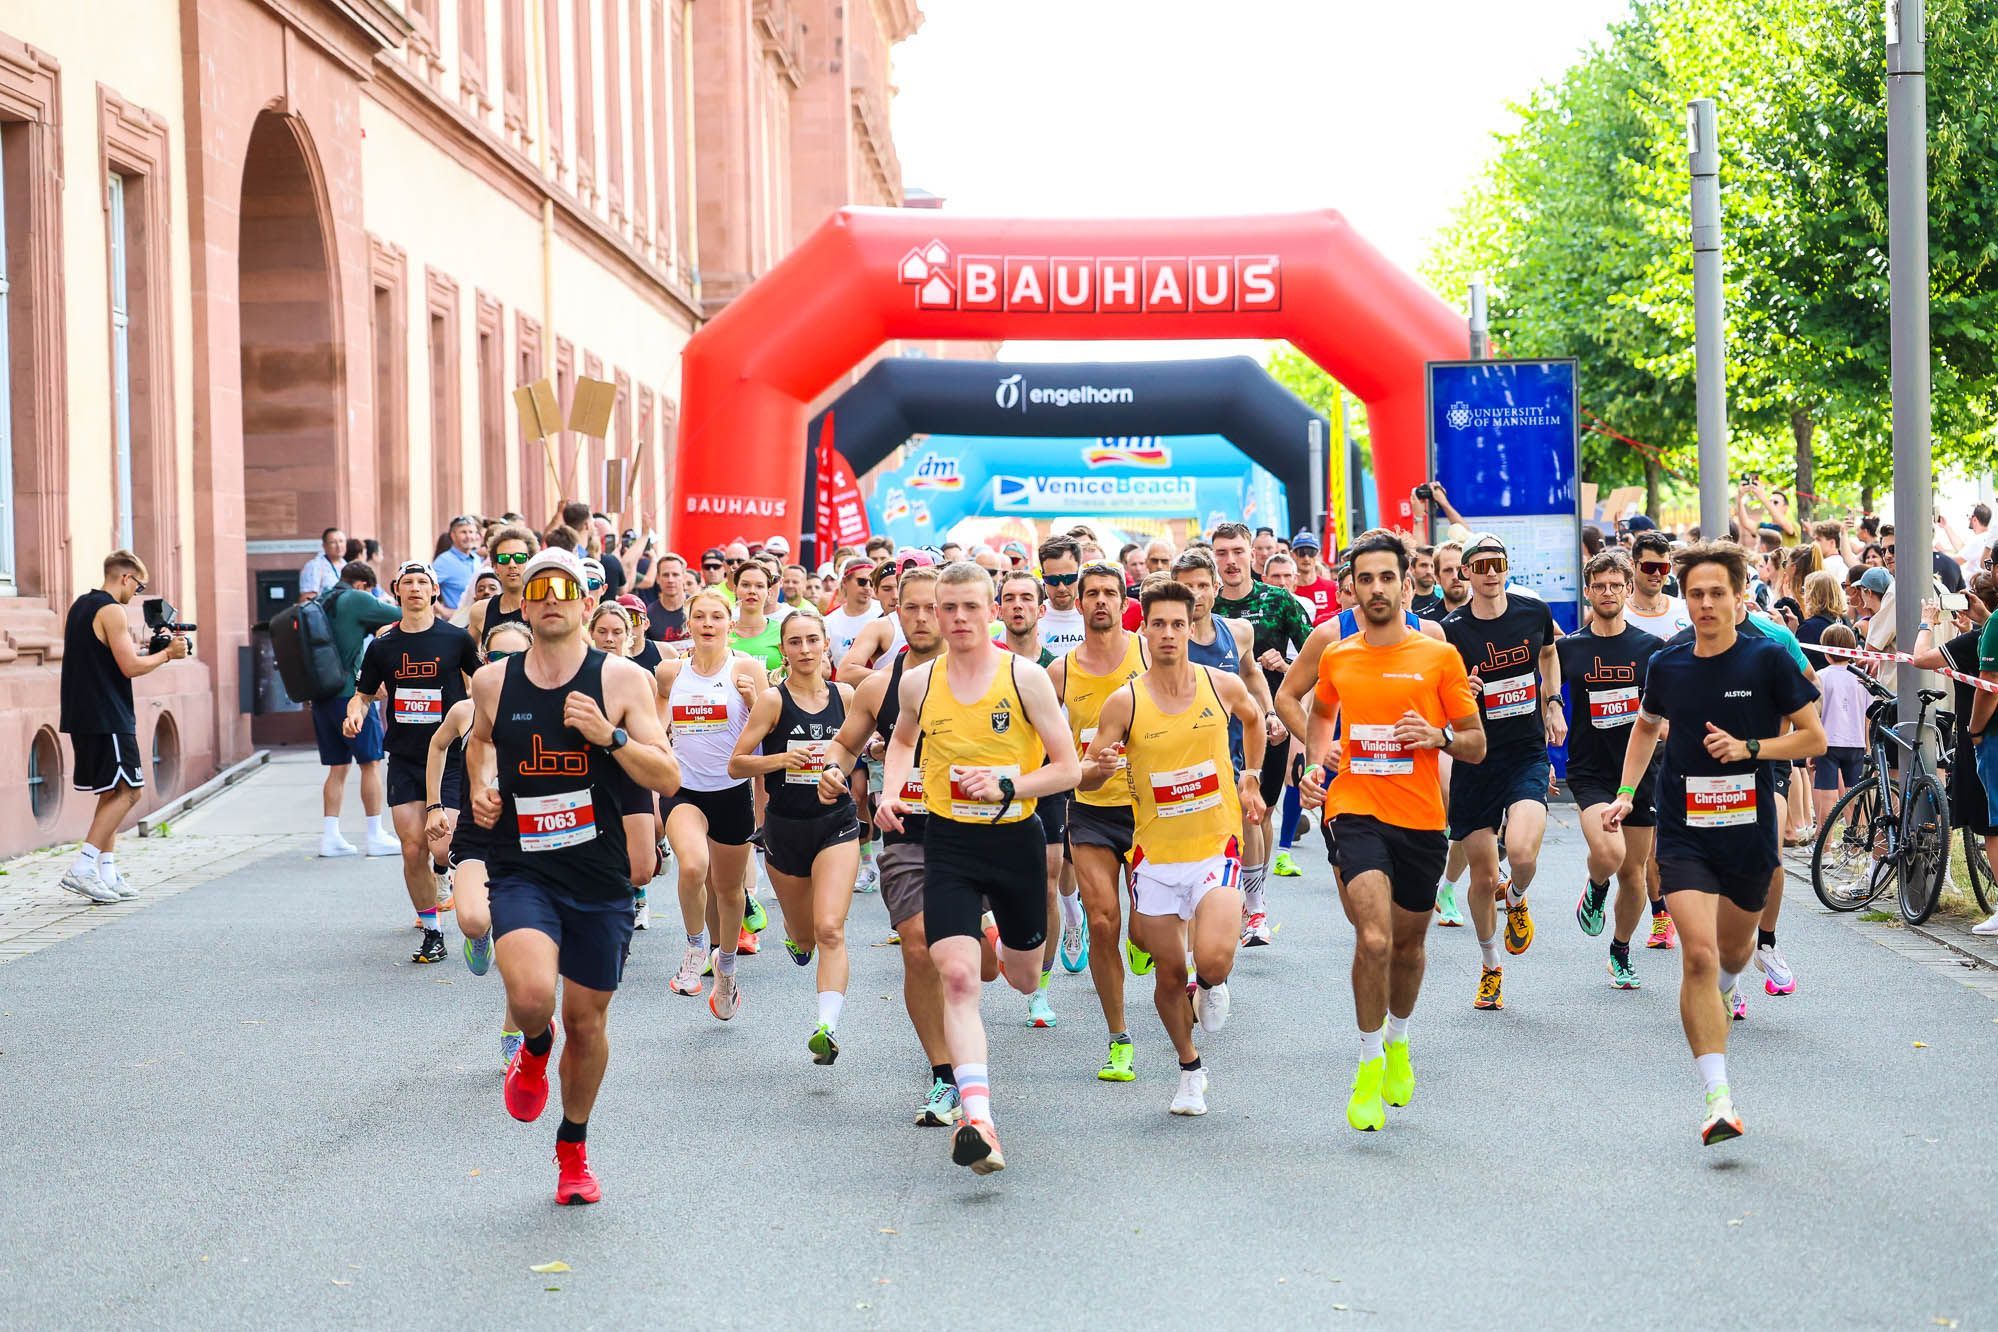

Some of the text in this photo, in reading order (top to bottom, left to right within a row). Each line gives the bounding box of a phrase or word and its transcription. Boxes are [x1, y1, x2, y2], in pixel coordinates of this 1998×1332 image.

[965, 264, 1276, 306] BAUHAUS
[1029, 386, 1134, 407] engelhorn
[1474, 407, 1544, 417] UNIVERSITY
[1474, 416, 1560, 427] OF MANNHEIM
[918, 456, 955, 477] dm
[1036, 476, 1191, 494] VeniceBeach
[686, 497, 786, 517] BAUHAUS
[1061, 634, 1084, 643] HAA
[1497, 689, 1528, 705] 7062
[1724, 690, 1752, 698] ALSTOM
[404, 701, 431, 711] 7067
[685, 706, 713, 715] Louise
[1601, 701, 1628, 715] 7061
[512, 713, 533, 721] JAKO
[1360, 740, 1402, 752] Vinicius
[1171, 782, 1202, 796] Jonas
[1694, 791, 1747, 805] Christoph
[533, 812, 578, 832] 7063
